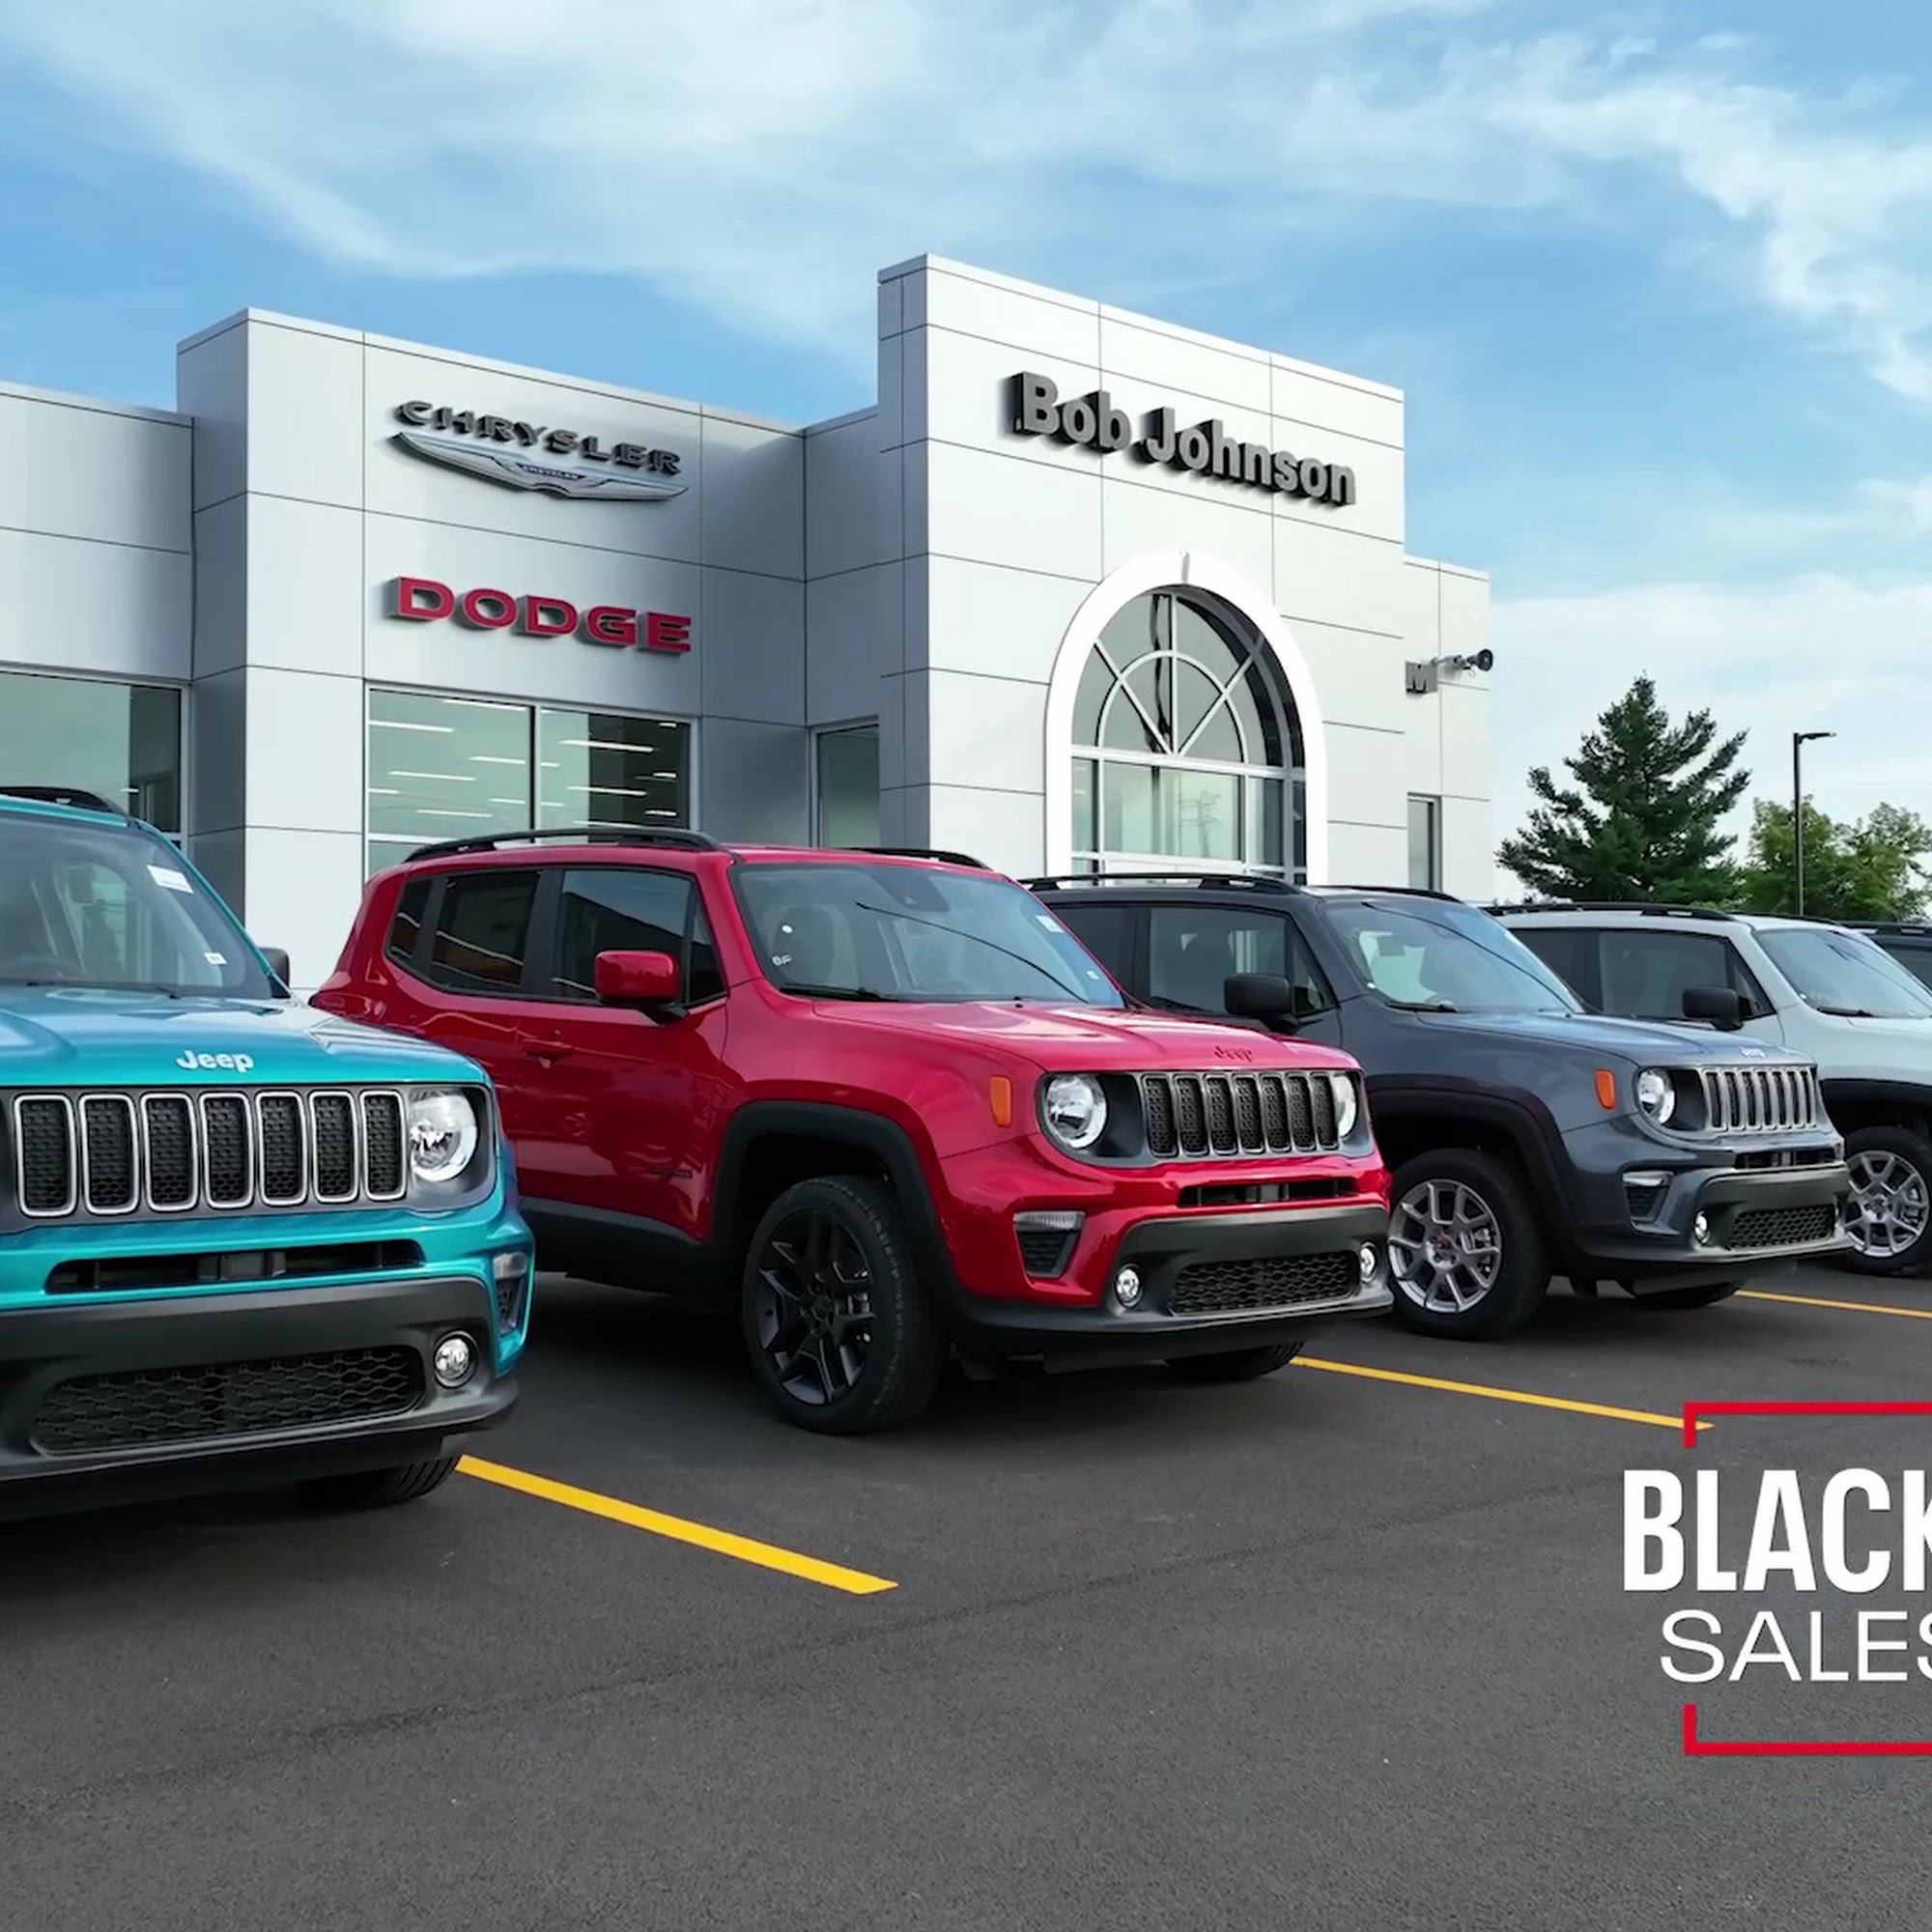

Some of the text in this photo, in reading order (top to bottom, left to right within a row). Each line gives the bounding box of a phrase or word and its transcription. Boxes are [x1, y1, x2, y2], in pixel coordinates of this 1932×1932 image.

[393, 400, 682, 476] CHRYSLER
[1007, 370, 1356, 506] Bob Johnson
[388, 576, 692, 654] DODGE
[175, 1049, 255, 1074] Jeep
